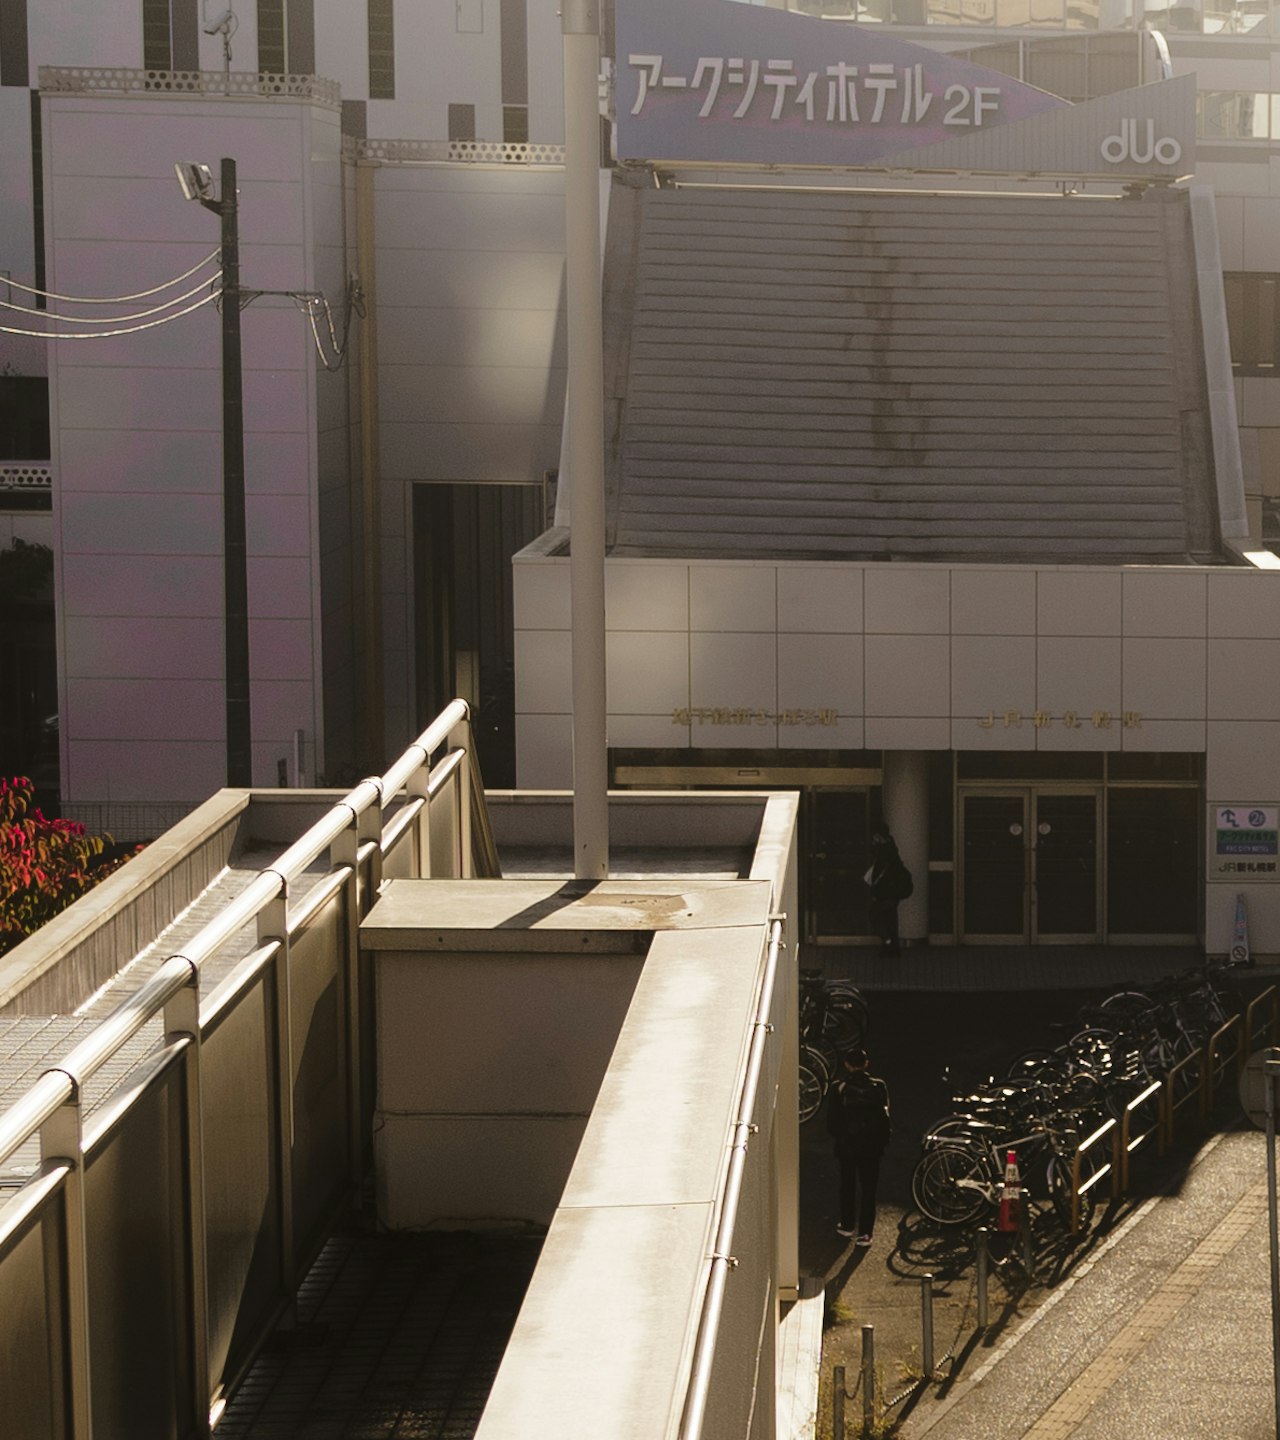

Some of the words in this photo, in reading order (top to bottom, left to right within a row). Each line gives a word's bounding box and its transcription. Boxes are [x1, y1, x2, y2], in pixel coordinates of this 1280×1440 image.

[627, 53, 933, 125] アークシティホテル
[942, 83, 1002, 127] 2F
